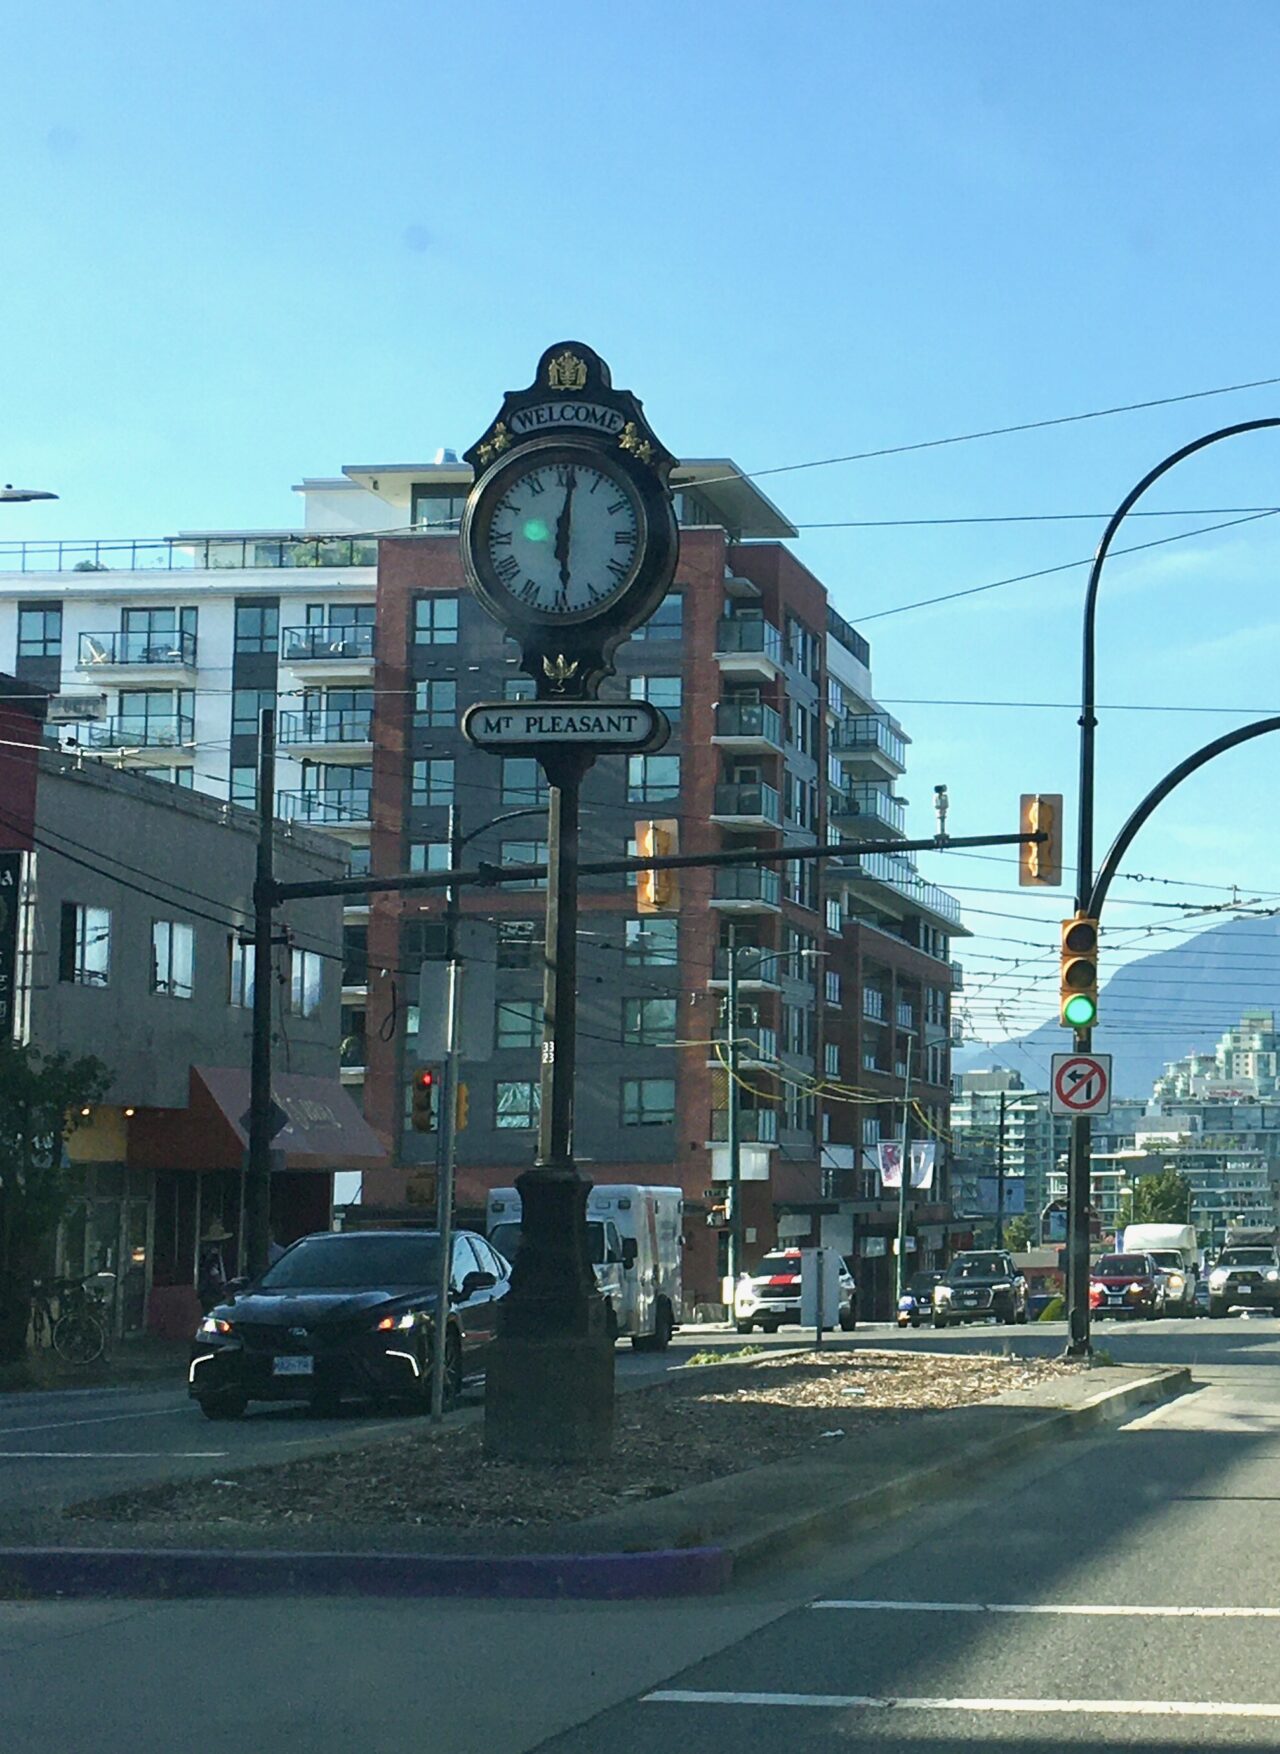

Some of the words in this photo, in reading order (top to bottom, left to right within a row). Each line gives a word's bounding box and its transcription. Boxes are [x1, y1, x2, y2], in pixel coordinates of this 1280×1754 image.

[516, 404, 621, 431] WELCOME
[525, 716, 637, 733] PLEASANT
[542, 1041, 555, 1053] 33
[542, 1052, 555, 1064] 23
